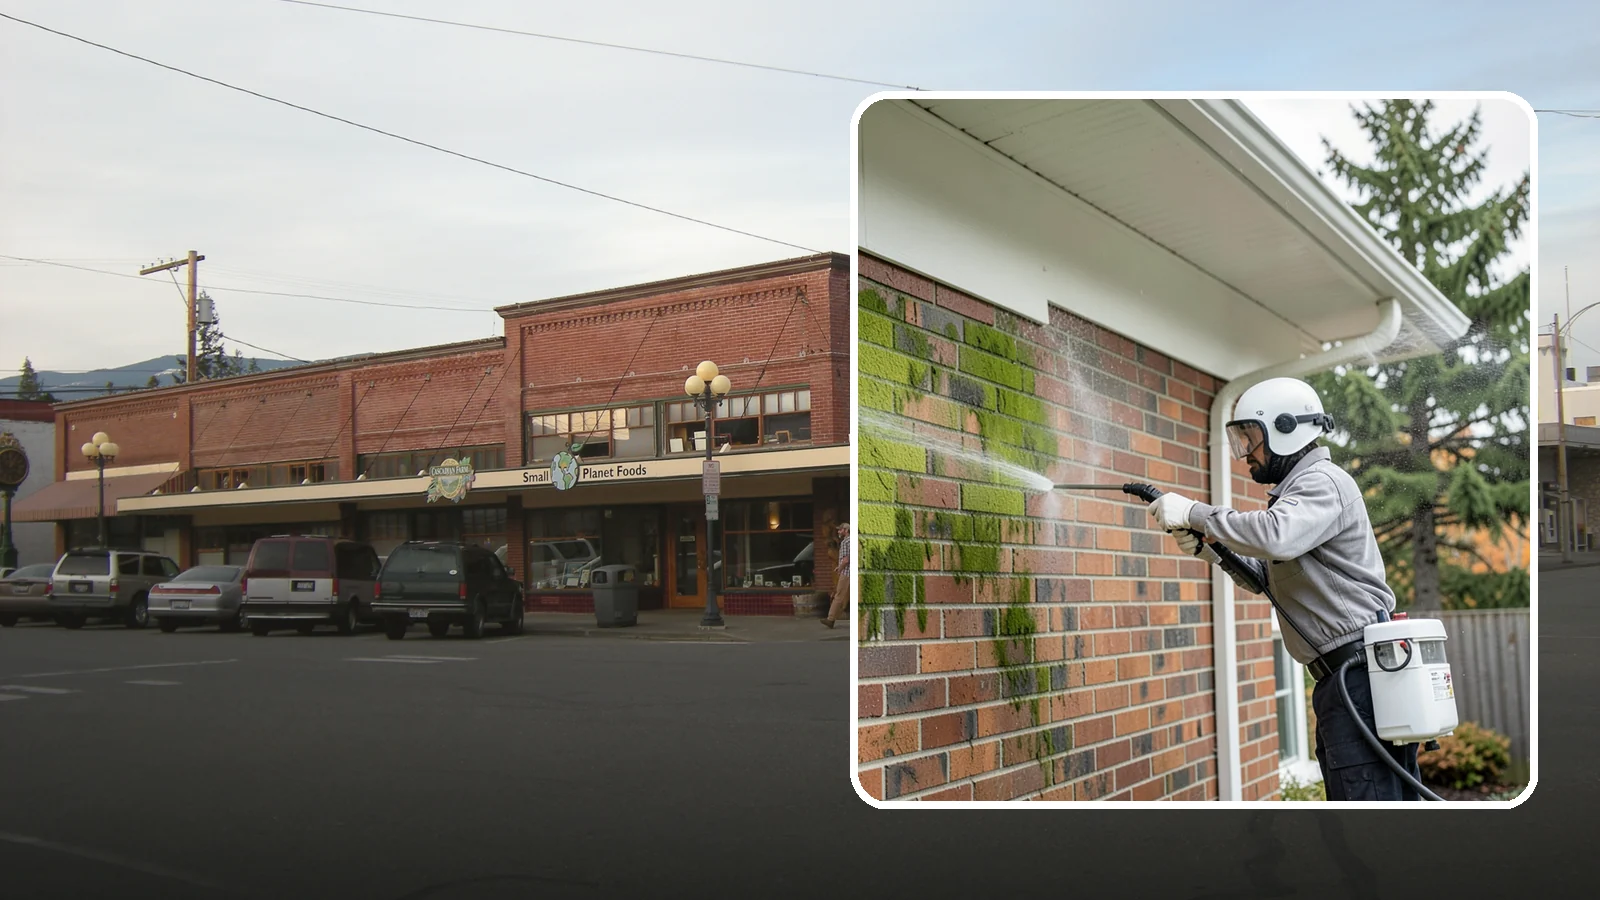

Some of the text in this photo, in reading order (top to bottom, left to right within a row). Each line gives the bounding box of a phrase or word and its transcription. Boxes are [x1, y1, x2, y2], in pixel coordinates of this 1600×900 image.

[523, 464, 647, 483] Small Planet Foods
